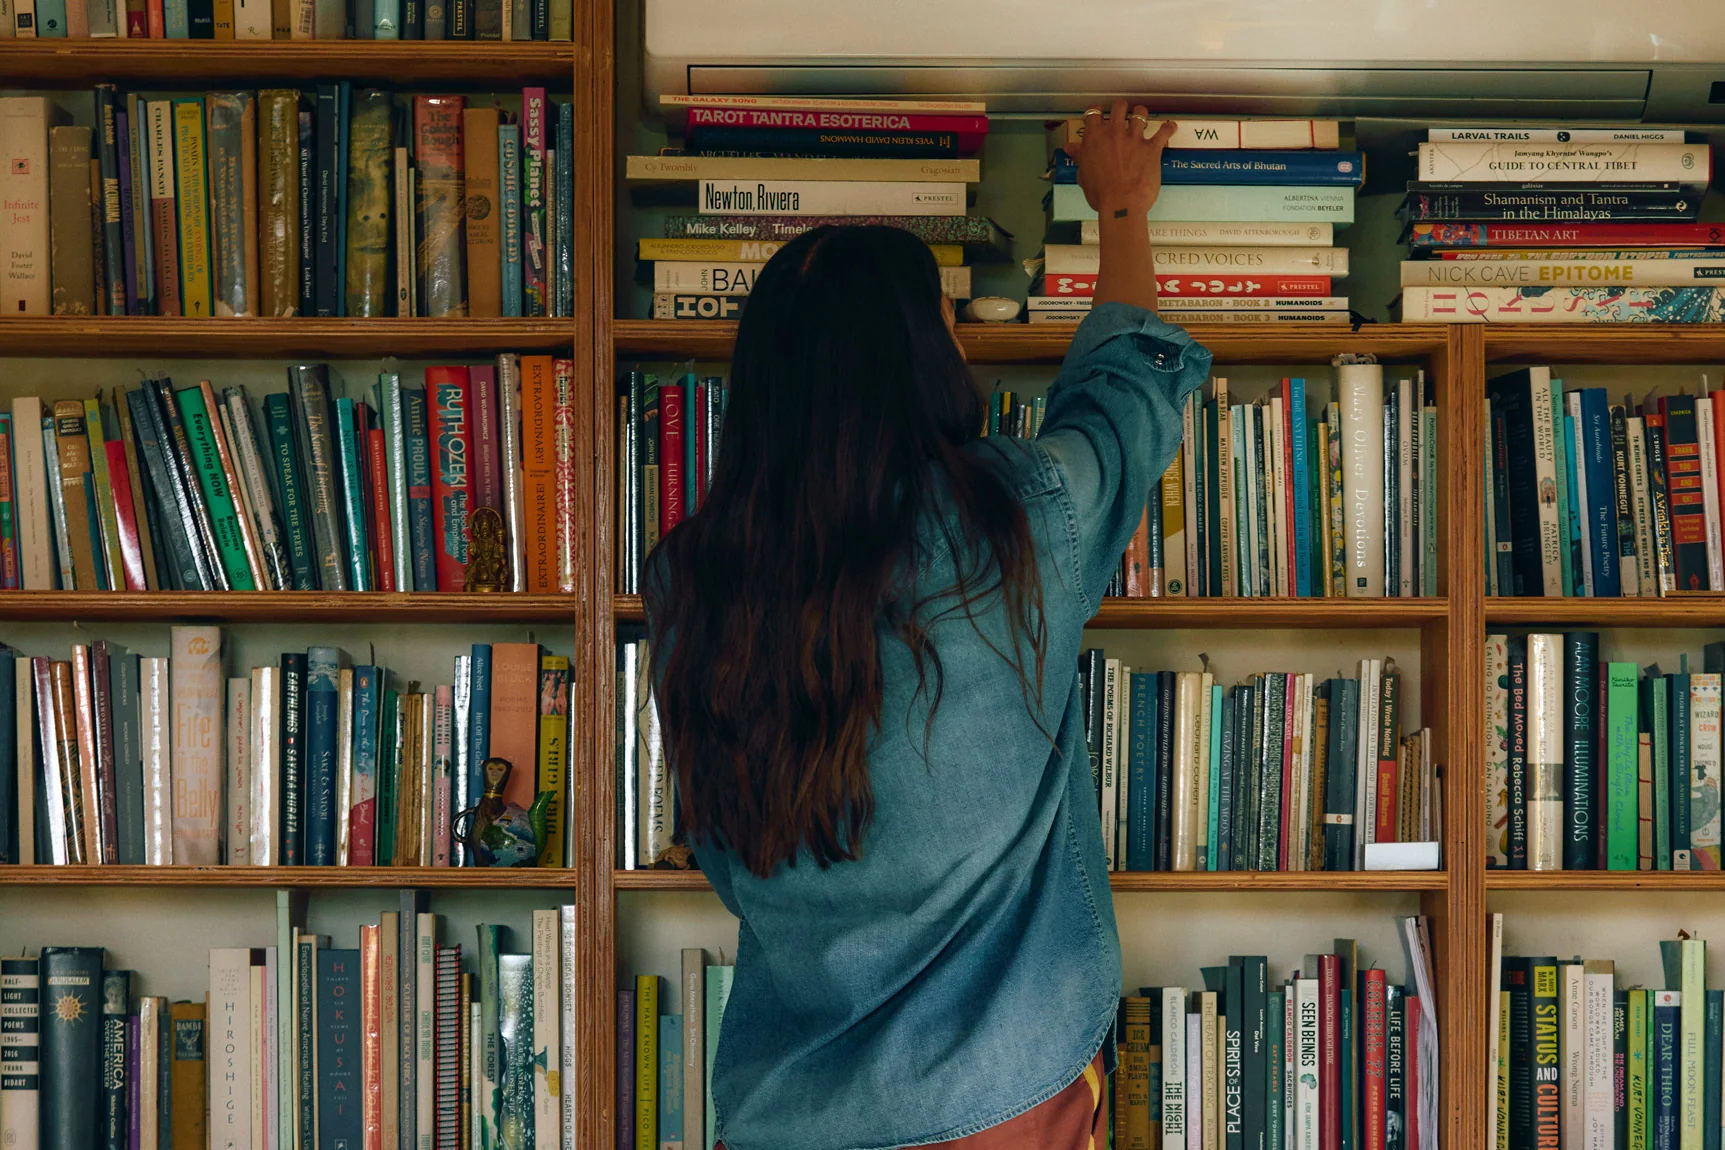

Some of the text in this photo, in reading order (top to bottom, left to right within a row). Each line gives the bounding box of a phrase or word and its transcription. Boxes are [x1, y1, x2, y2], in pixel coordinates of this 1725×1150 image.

[693, 110, 910, 128] TAROT TANTRA ESOTERICA
[1452, 132, 1491, 140] LARVAL
[155, 108, 165, 195] CHARLES PANATI
[528, 98, 541, 207] Sassy Planet
[1171, 160, 1286, 170] The Sacred Arts of Bhutan
[1489, 161, 1637, 170] GUIDE TO CENTRAL TIBET
[504, 140, 517, 263] COSMIC COOKERY
[705, 183, 799, 212] Newton, Riviera
[1484, 193, 1628, 205] Shamanism and Tantra
[1503, 207, 1611, 221] in the Himalayas
[687, 223, 756, 237] Mike Kelley
[1492, 230, 1579, 240] TIBETAN ART
[1204, 253, 1263, 265] VOICES
[1429, 266, 1633, 281] NICK CAVE EPITOME
[446, 388, 467, 488] RUTH OZEKI
[534, 365, 544, 464] EXTRAORDINARY!
[193, 413, 224, 497] Everything NOW
[410, 396, 426, 485] Annie PROULX
[665, 394, 679, 519] LOVE TURNING
[280, 443, 303, 557] TO SPEAK FOR THE TREES
[1351, 383, 1369, 567] Mary Oliver Devotions
[1615, 451, 1628, 514] KURT VONNEGUT
[460, 494, 468, 508] The
[461, 510, 469, 529] Book
[451, 500, 460, 558] and Emptiness
[461, 532, 468, 542] of
[1600, 506, 1611, 577] The Future Poetry
[1382, 677, 1394, 698] Today
[1383, 705, 1393, 725] Wrote
[286, 671, 298, 833] EARTHLINGS SAYAKA MURATA
[1382, 727, 1394, 756] Nothing
[1513, 663, 1523, 841] The Bed Moved Rebecca Schiff
[1574, 642, 1590, 841] ALAN MOORE ILLUMINATIONS
[643, 987, 651, 1003] THE
[1538, 971, 1548, 992] MARX
[301, 946, 311, 1099] Encyclopedia of Native American Healing
[1536, 1004, 1557, 1064] STATUS
[113, 1019, 124, 1089] AMERICA
[487, 1033, 495, 1083] THE FOREST
[1301, 1030, 1315, 1066] BEINGS
[1390, 1011, 1401, 1099] LIFE BEFORE LIFE
[1661, 1023, 1672, 1106] DEAR THEO
[1537, 1068, 1557, 1081] AND
